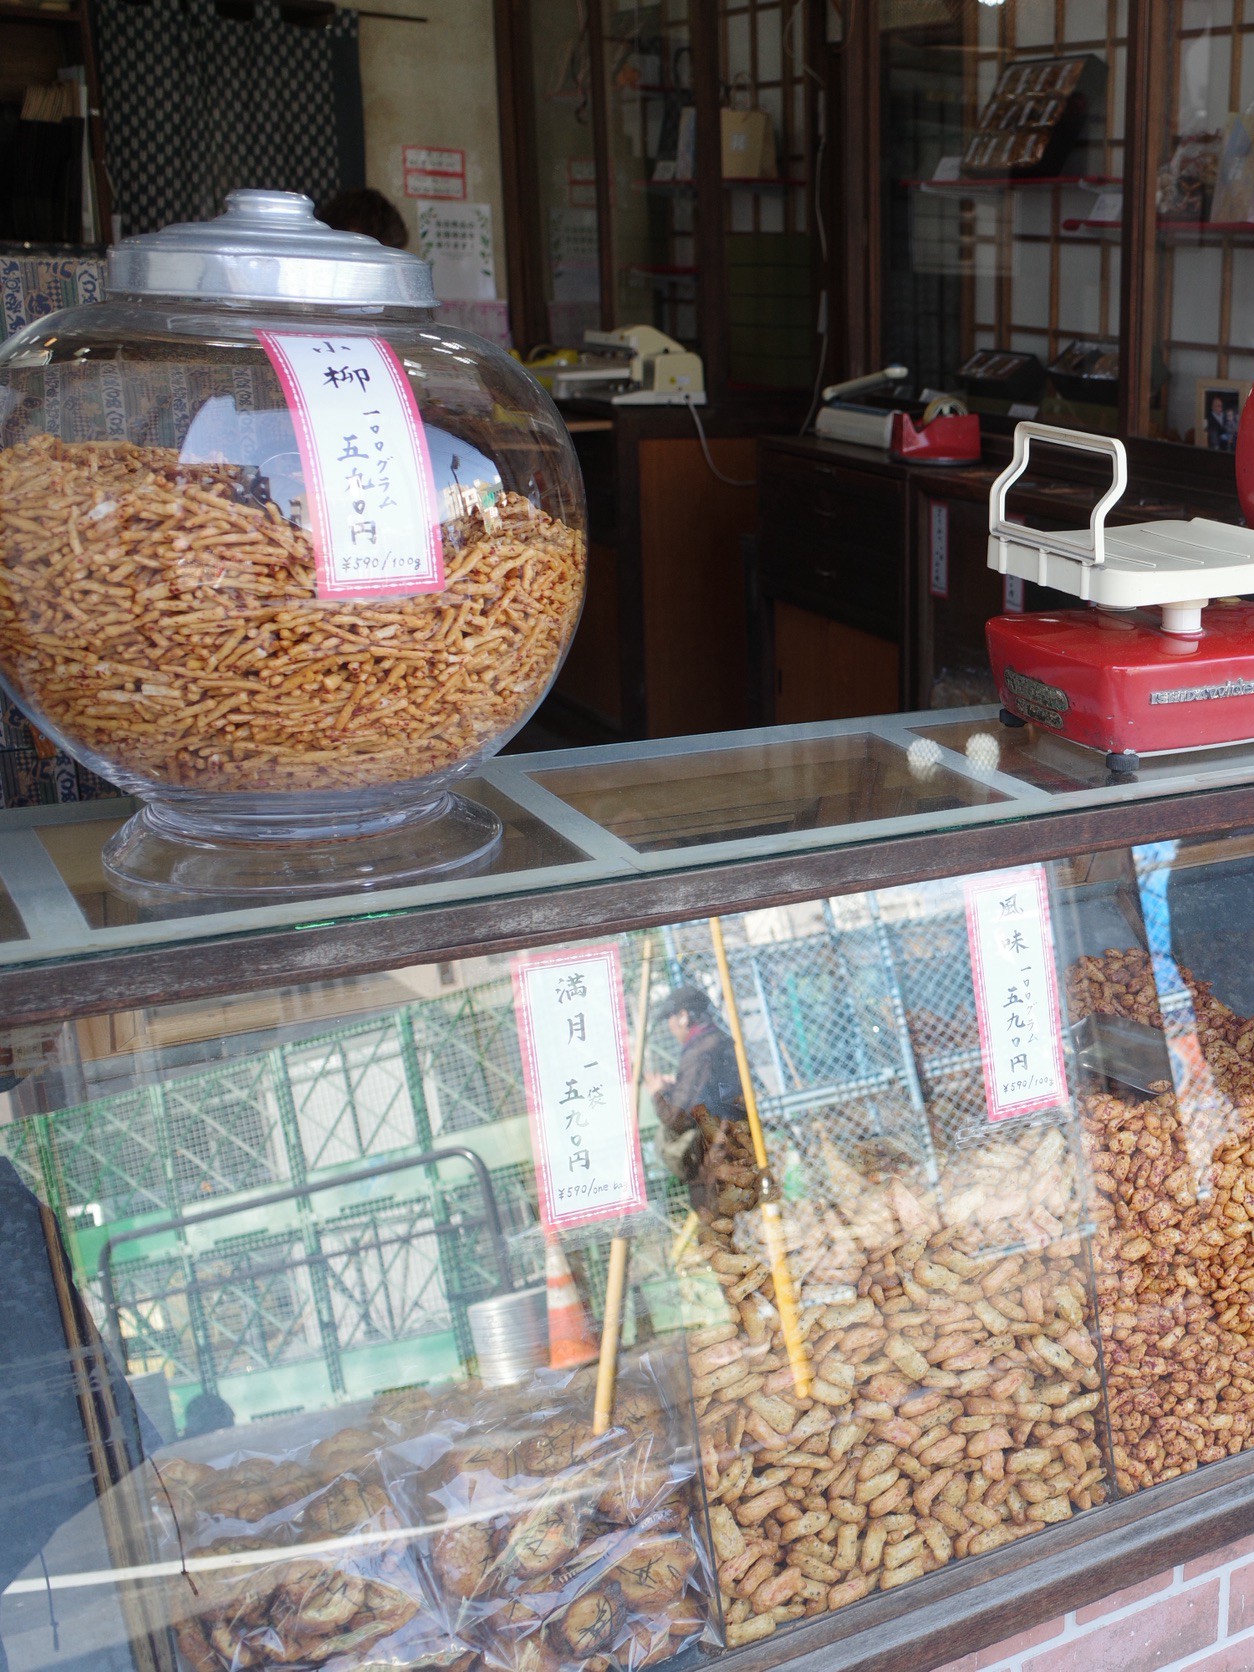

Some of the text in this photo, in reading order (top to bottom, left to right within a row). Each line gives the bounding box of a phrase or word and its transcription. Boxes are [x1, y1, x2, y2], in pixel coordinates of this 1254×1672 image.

[312, 341, 371, 393] 小柳
[341, 551, 422, 571] ¥590/100g
[999, 893, 1030, 955] 風味
[555, 972, 588, 1045] 満月
[583, 1060, 607, 1110] 一袋
[1002, 1074, 1055, 1093] ¥590/100g
[558, 1178, 609, 1200] ¥590/one
